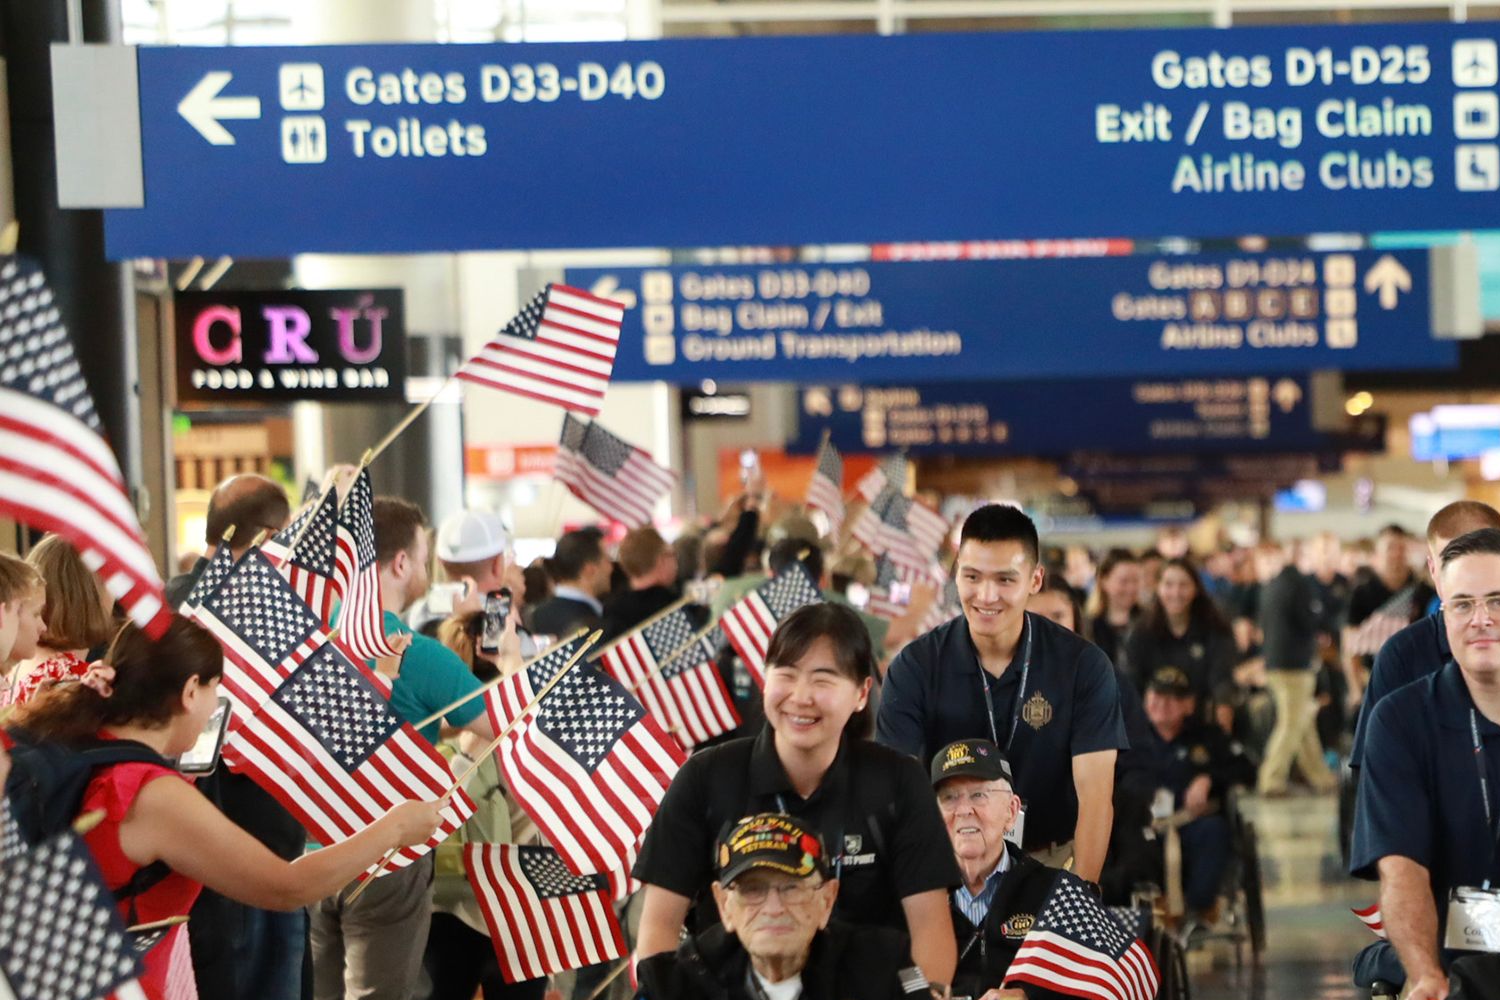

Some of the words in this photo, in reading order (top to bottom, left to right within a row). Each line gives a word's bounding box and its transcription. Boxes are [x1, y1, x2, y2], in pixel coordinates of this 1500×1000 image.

[345, 65, 467, 105] Gates
[481, 60, 666, 103] D33-D40
[1151, 49, 1272, 89] Gates
[1285, 44, 1431, 87] D1-D25
[345, 117, 487, 158] Toilets
[1095, 101, 1172, 143] Exit
[1184, 101, 1210, 146] /
[1223, 100, 1303, 149] Bag
[1315, 97, 1432, 138] Claim
[1171, 152, 1306, 194] Airline
[1318, 149, 1434, 190] Clubs
[680, 272, 755, 300] Gates
[1148, 260, 1223, 290] Gates
[681, 303, 733, 337] Bag
[736, 300, 809, 330] Claim
[834, 299, 883, 328] Exit
[1112, 292, 1187, 321] Gates
[682, 333, 776, 362] Ground
[780, 328, 961, 363] Transportation
[1161, 321, 1243, 350] Airline
[1246, 320, 1319, 348] Clubs
